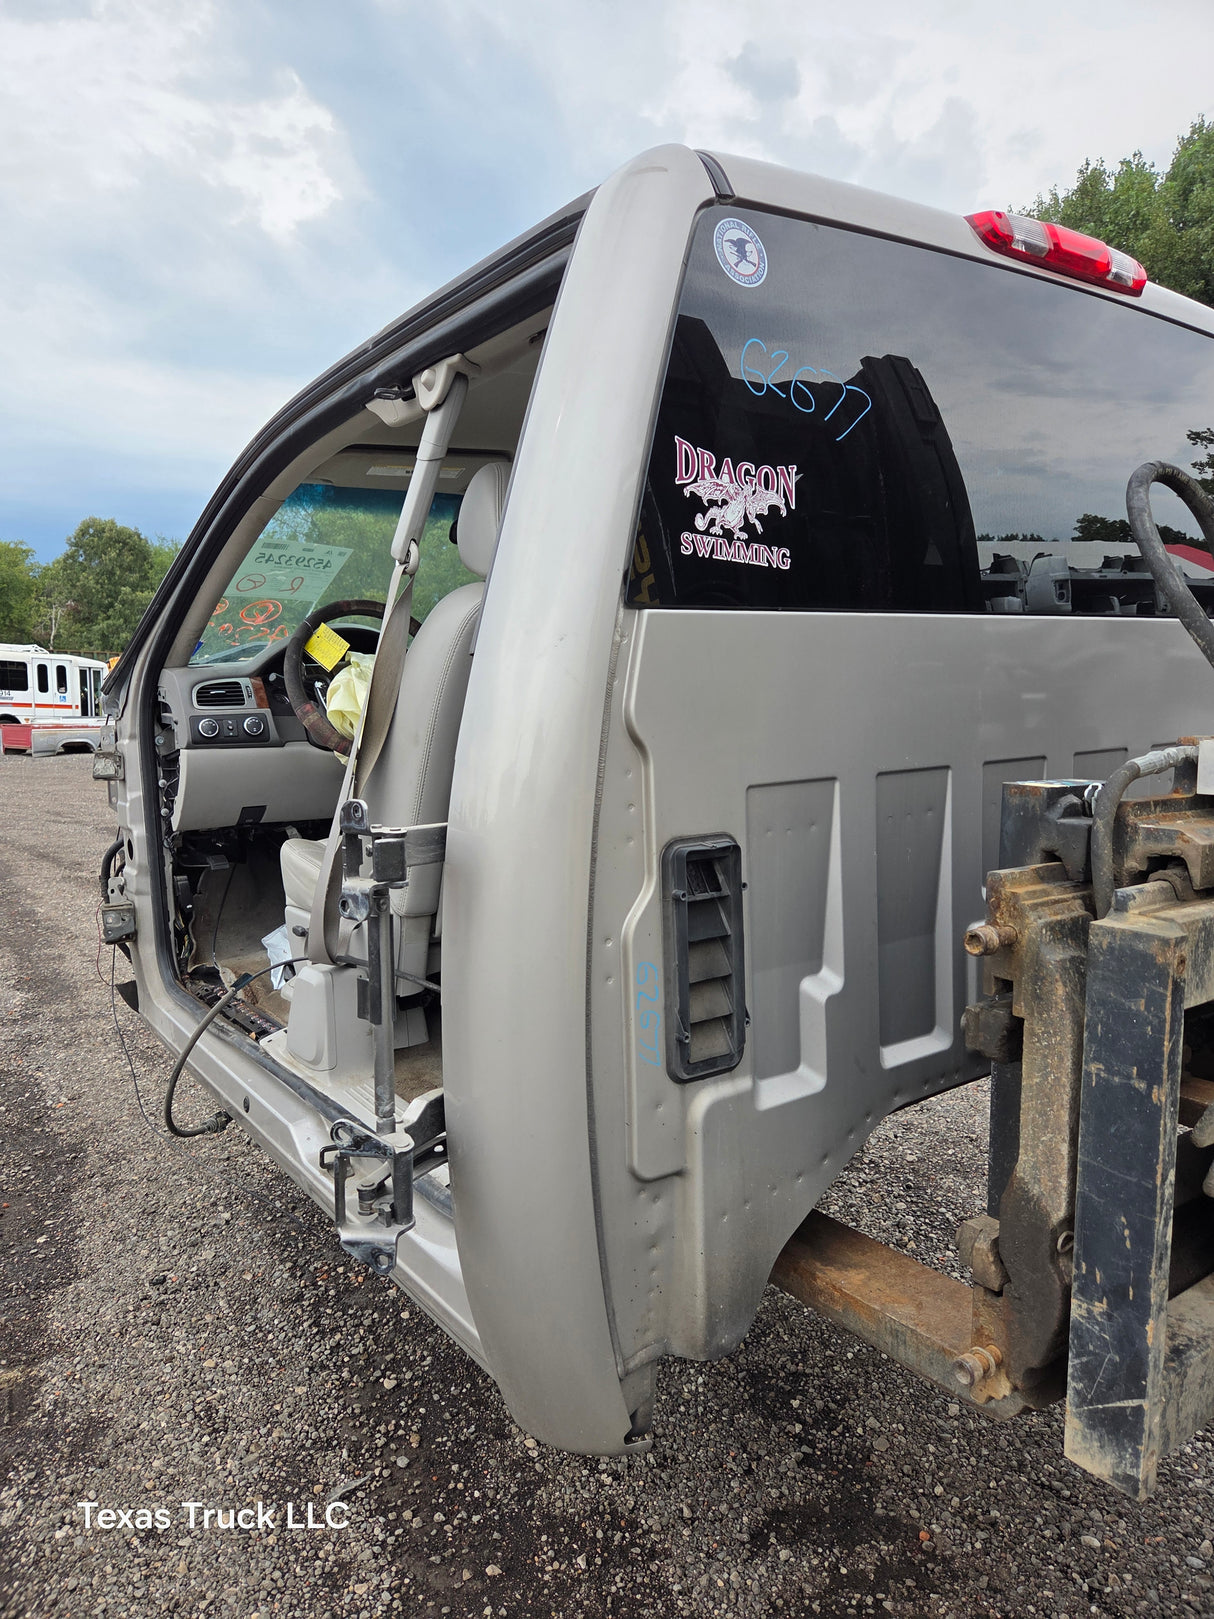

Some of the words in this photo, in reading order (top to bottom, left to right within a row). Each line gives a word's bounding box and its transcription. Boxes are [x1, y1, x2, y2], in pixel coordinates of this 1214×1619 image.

[740, 338, 872, 441] 62677
[674, 435, 797, 510] DRAGON
[680, 532, 792, 569] SWIMMING
[636, 961, 661, 1067] 62677
